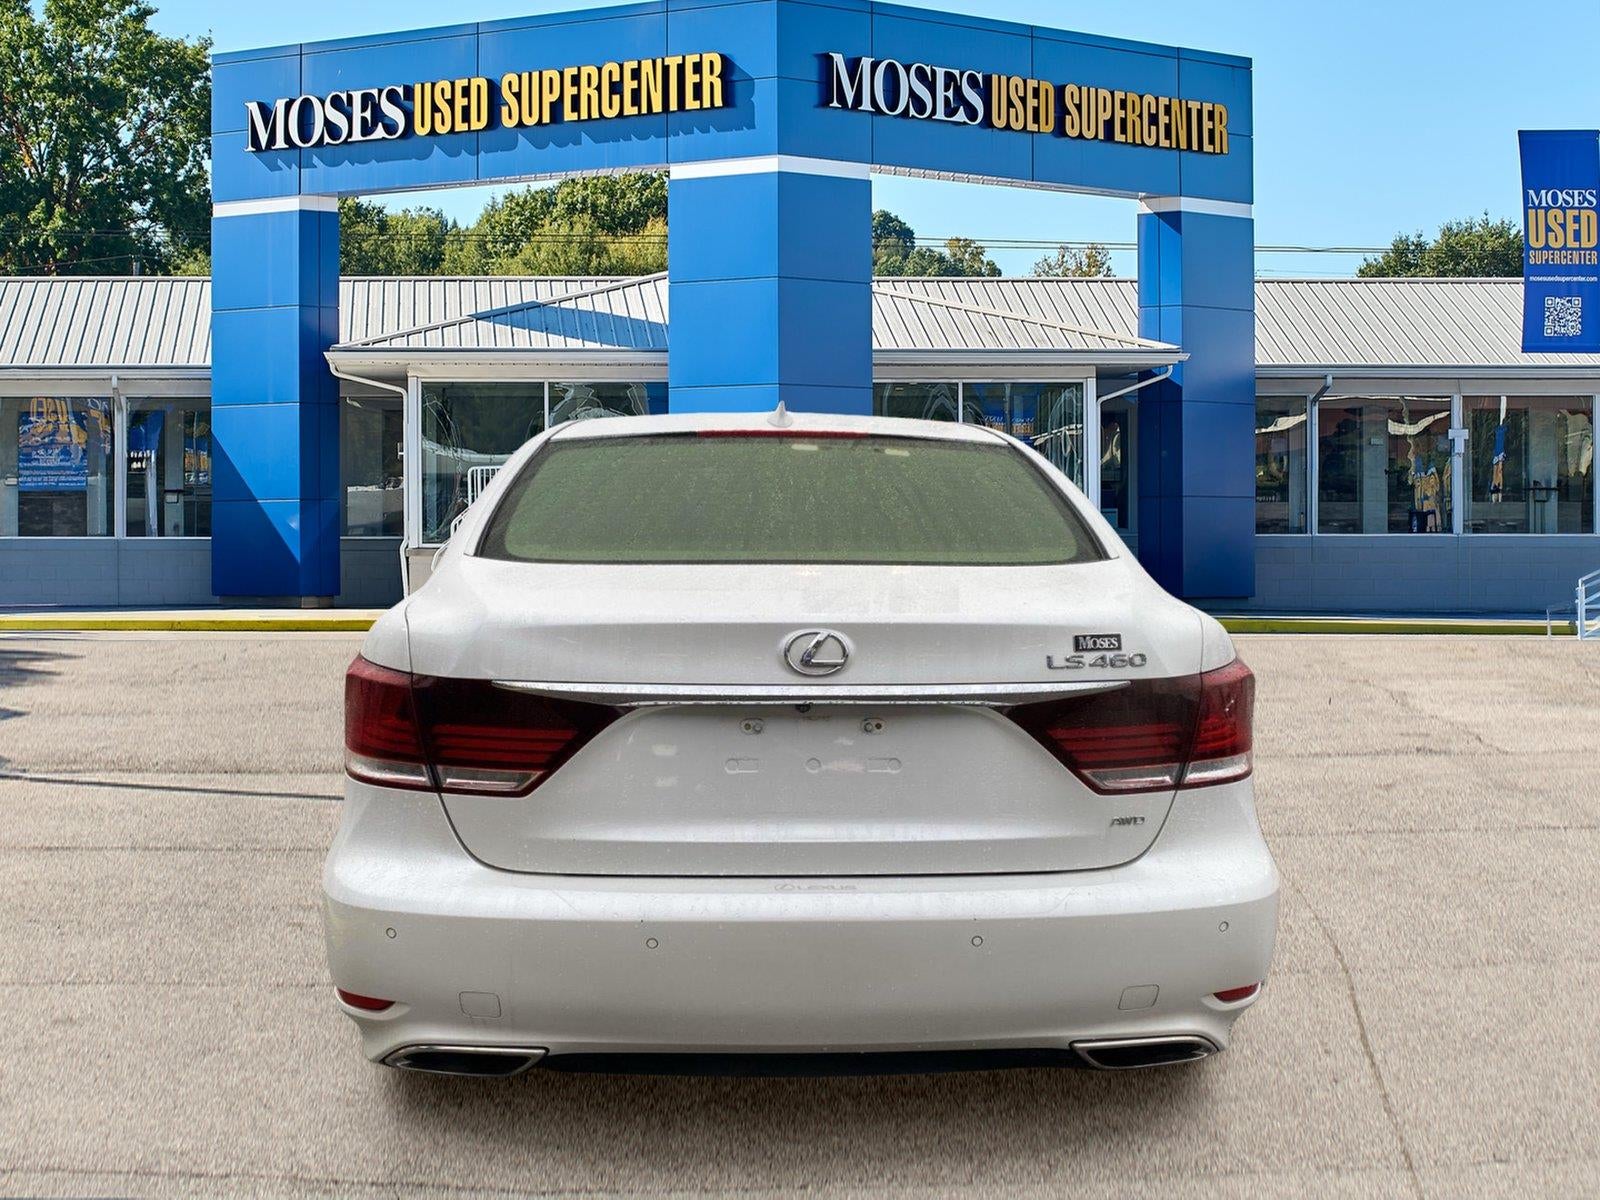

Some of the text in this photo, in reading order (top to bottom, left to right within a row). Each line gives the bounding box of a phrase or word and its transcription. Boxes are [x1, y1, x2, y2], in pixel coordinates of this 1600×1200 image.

[245, 52, 724, 152] MOSES USED SUPERCENTER
[828, 52, 1229, 155] MOSES USED SUPERCENTER
[1527, 189, 1597, 208] MOSES
[1528, 209, 1598, 248] USED
[1529, 250, 1598, 265] SUPERCENTER
[1046, 653, 1147, 670] LS 460
[1109, 816, 1145, 827] AWD
